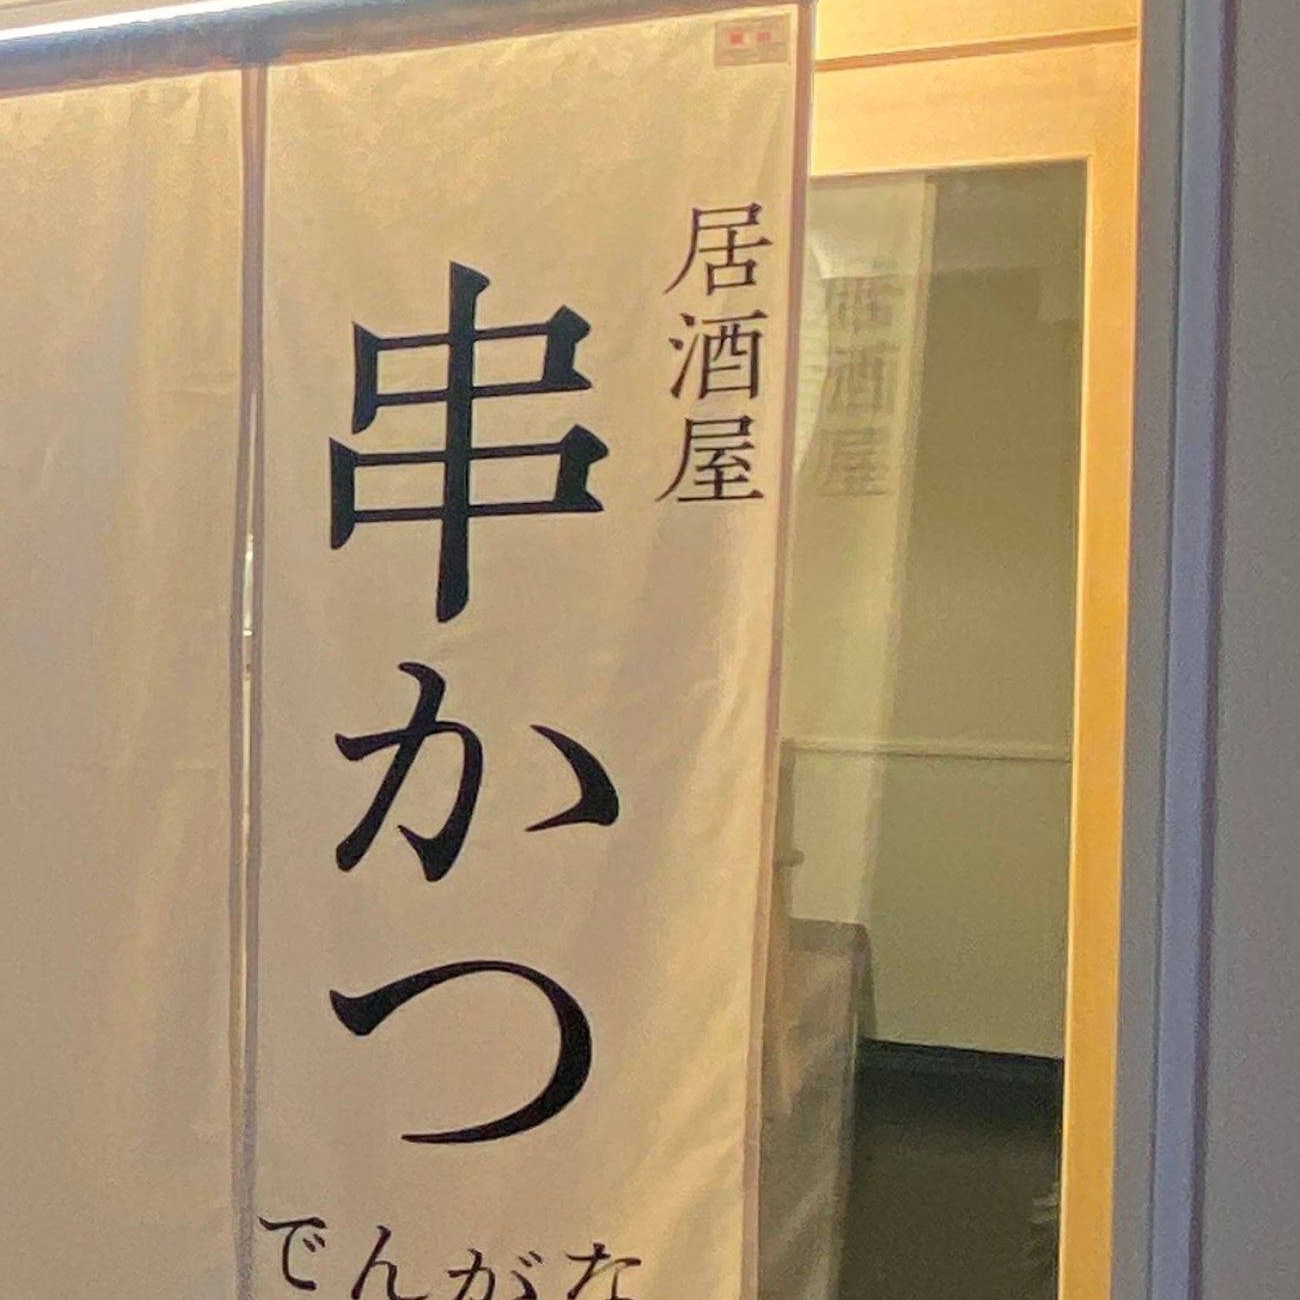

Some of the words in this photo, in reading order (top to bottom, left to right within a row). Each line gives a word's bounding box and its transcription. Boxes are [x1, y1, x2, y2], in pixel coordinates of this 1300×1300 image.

[655, 202, 773, 503] 居酒屋
[329, 260, 620, 1144] 串かつ
